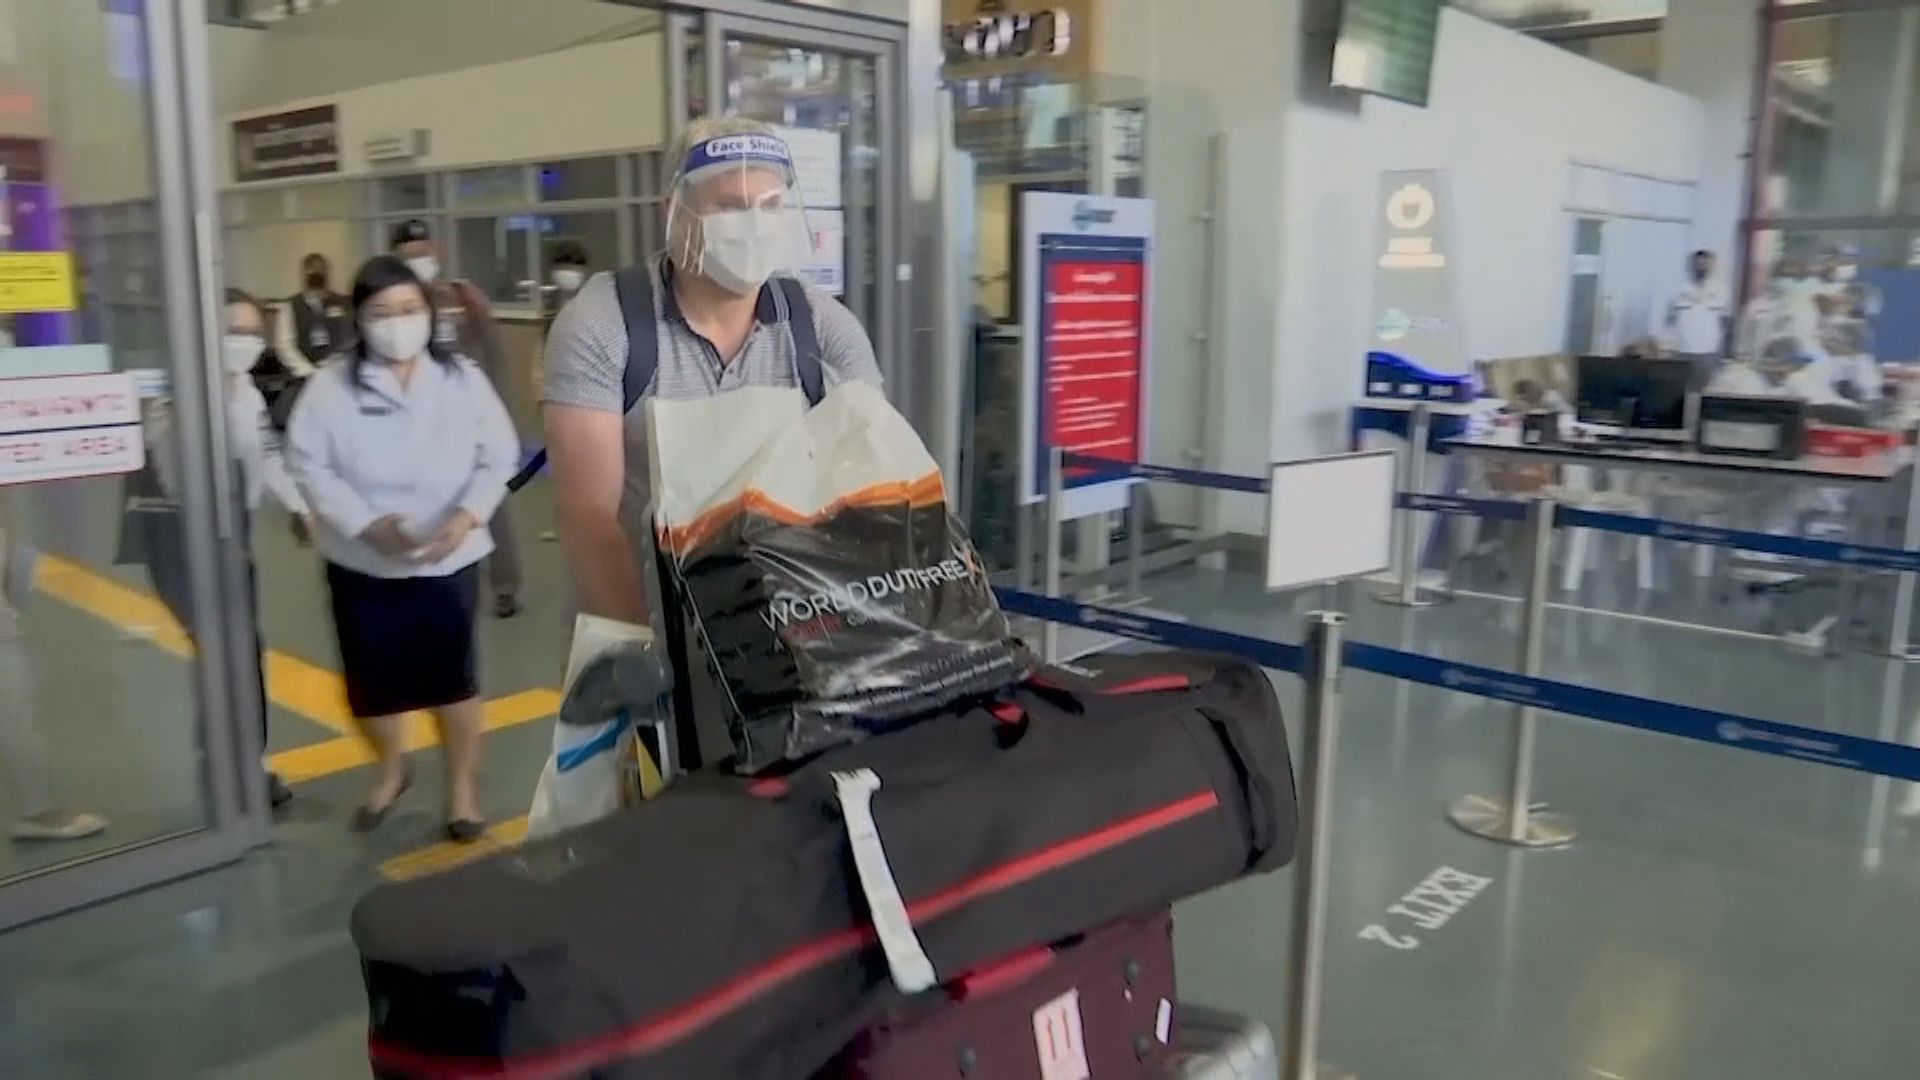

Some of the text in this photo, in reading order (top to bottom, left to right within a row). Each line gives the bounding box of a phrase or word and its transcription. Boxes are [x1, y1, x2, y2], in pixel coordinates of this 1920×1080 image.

[759, 581, 869, 632] WORLD
[1357, 865, 1494, 950] EXIT 2
